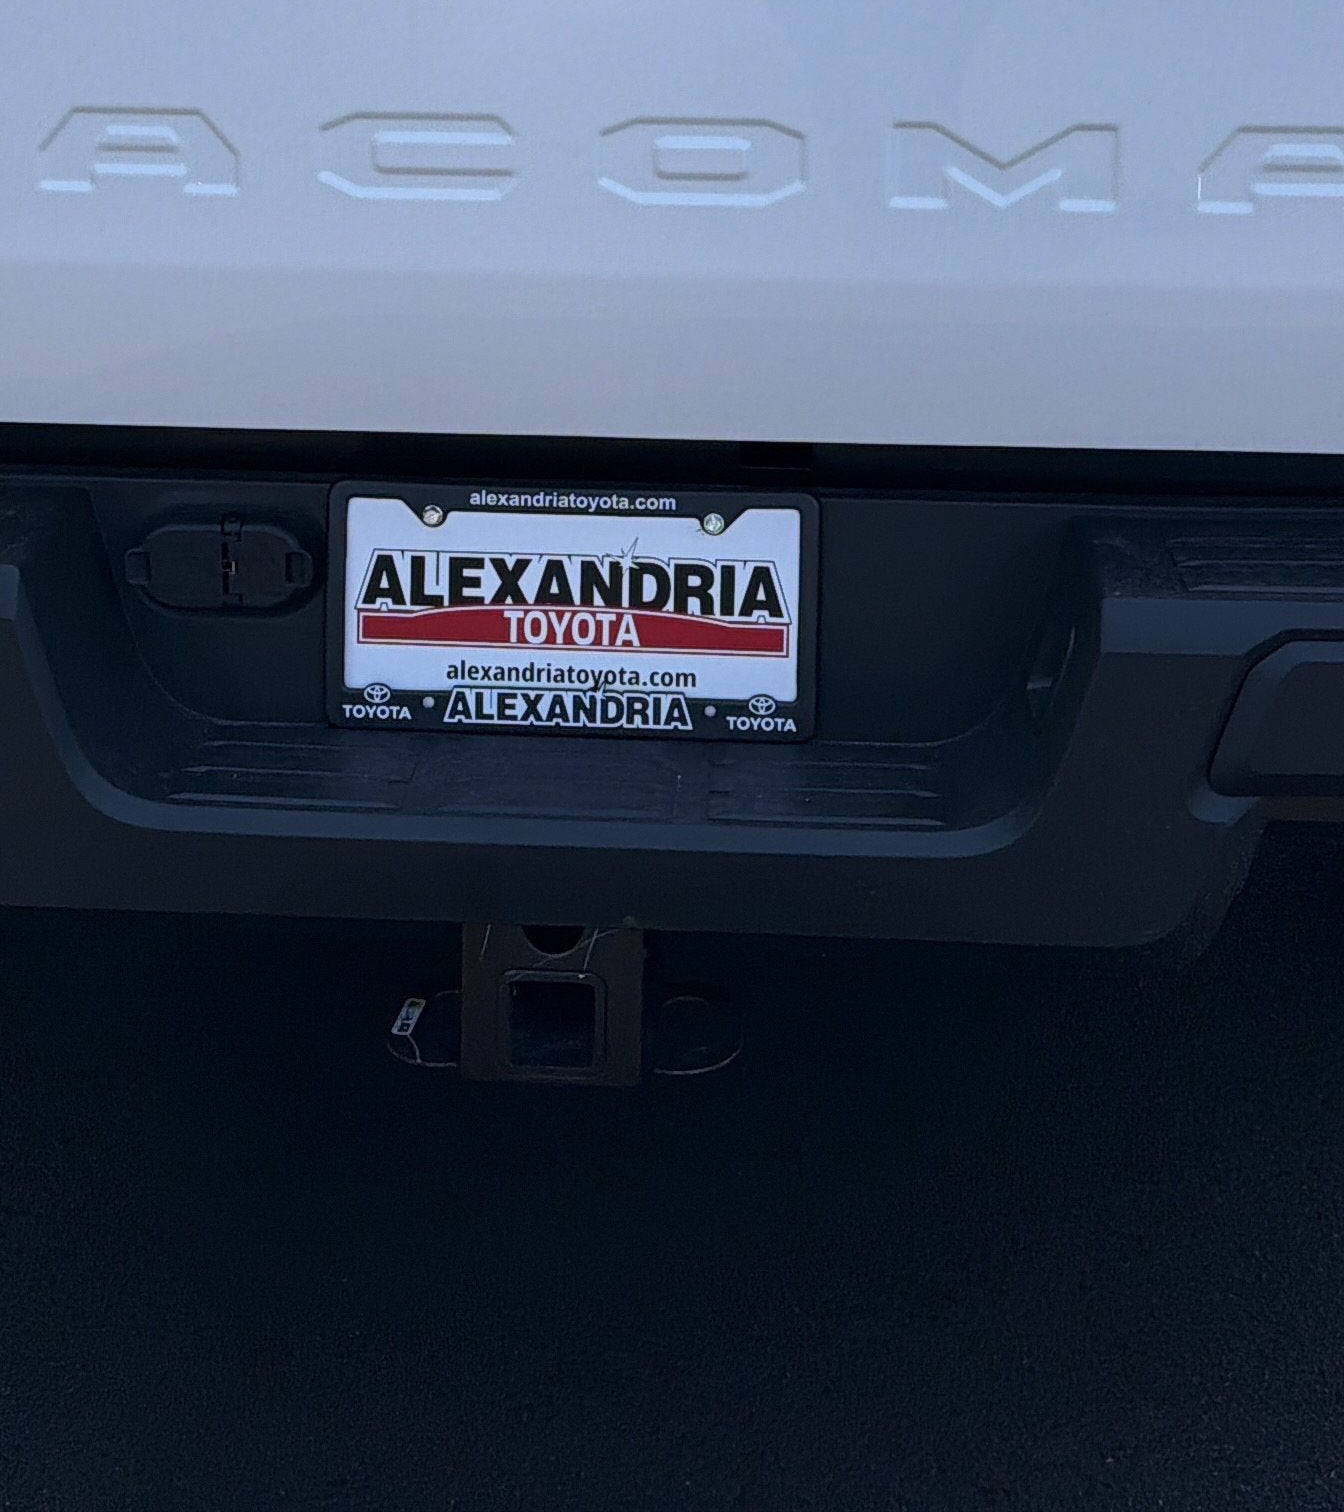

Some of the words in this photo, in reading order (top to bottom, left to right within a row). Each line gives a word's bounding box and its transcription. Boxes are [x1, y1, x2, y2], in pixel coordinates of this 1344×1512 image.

[468, 489, 677, 513] alexandriatoyota.com
[360, 552, 787, 620] ALEXANDRIA
[502, 609, 641, 648] TOYOTA
[446, 660, 697, 688] alexandriatoyota.com
[342, 704, 412, 720] TOYOTA
[445, 688, 693, 730] ALEXANDRIA
[726, 716, 797, 732] TOYOTA
